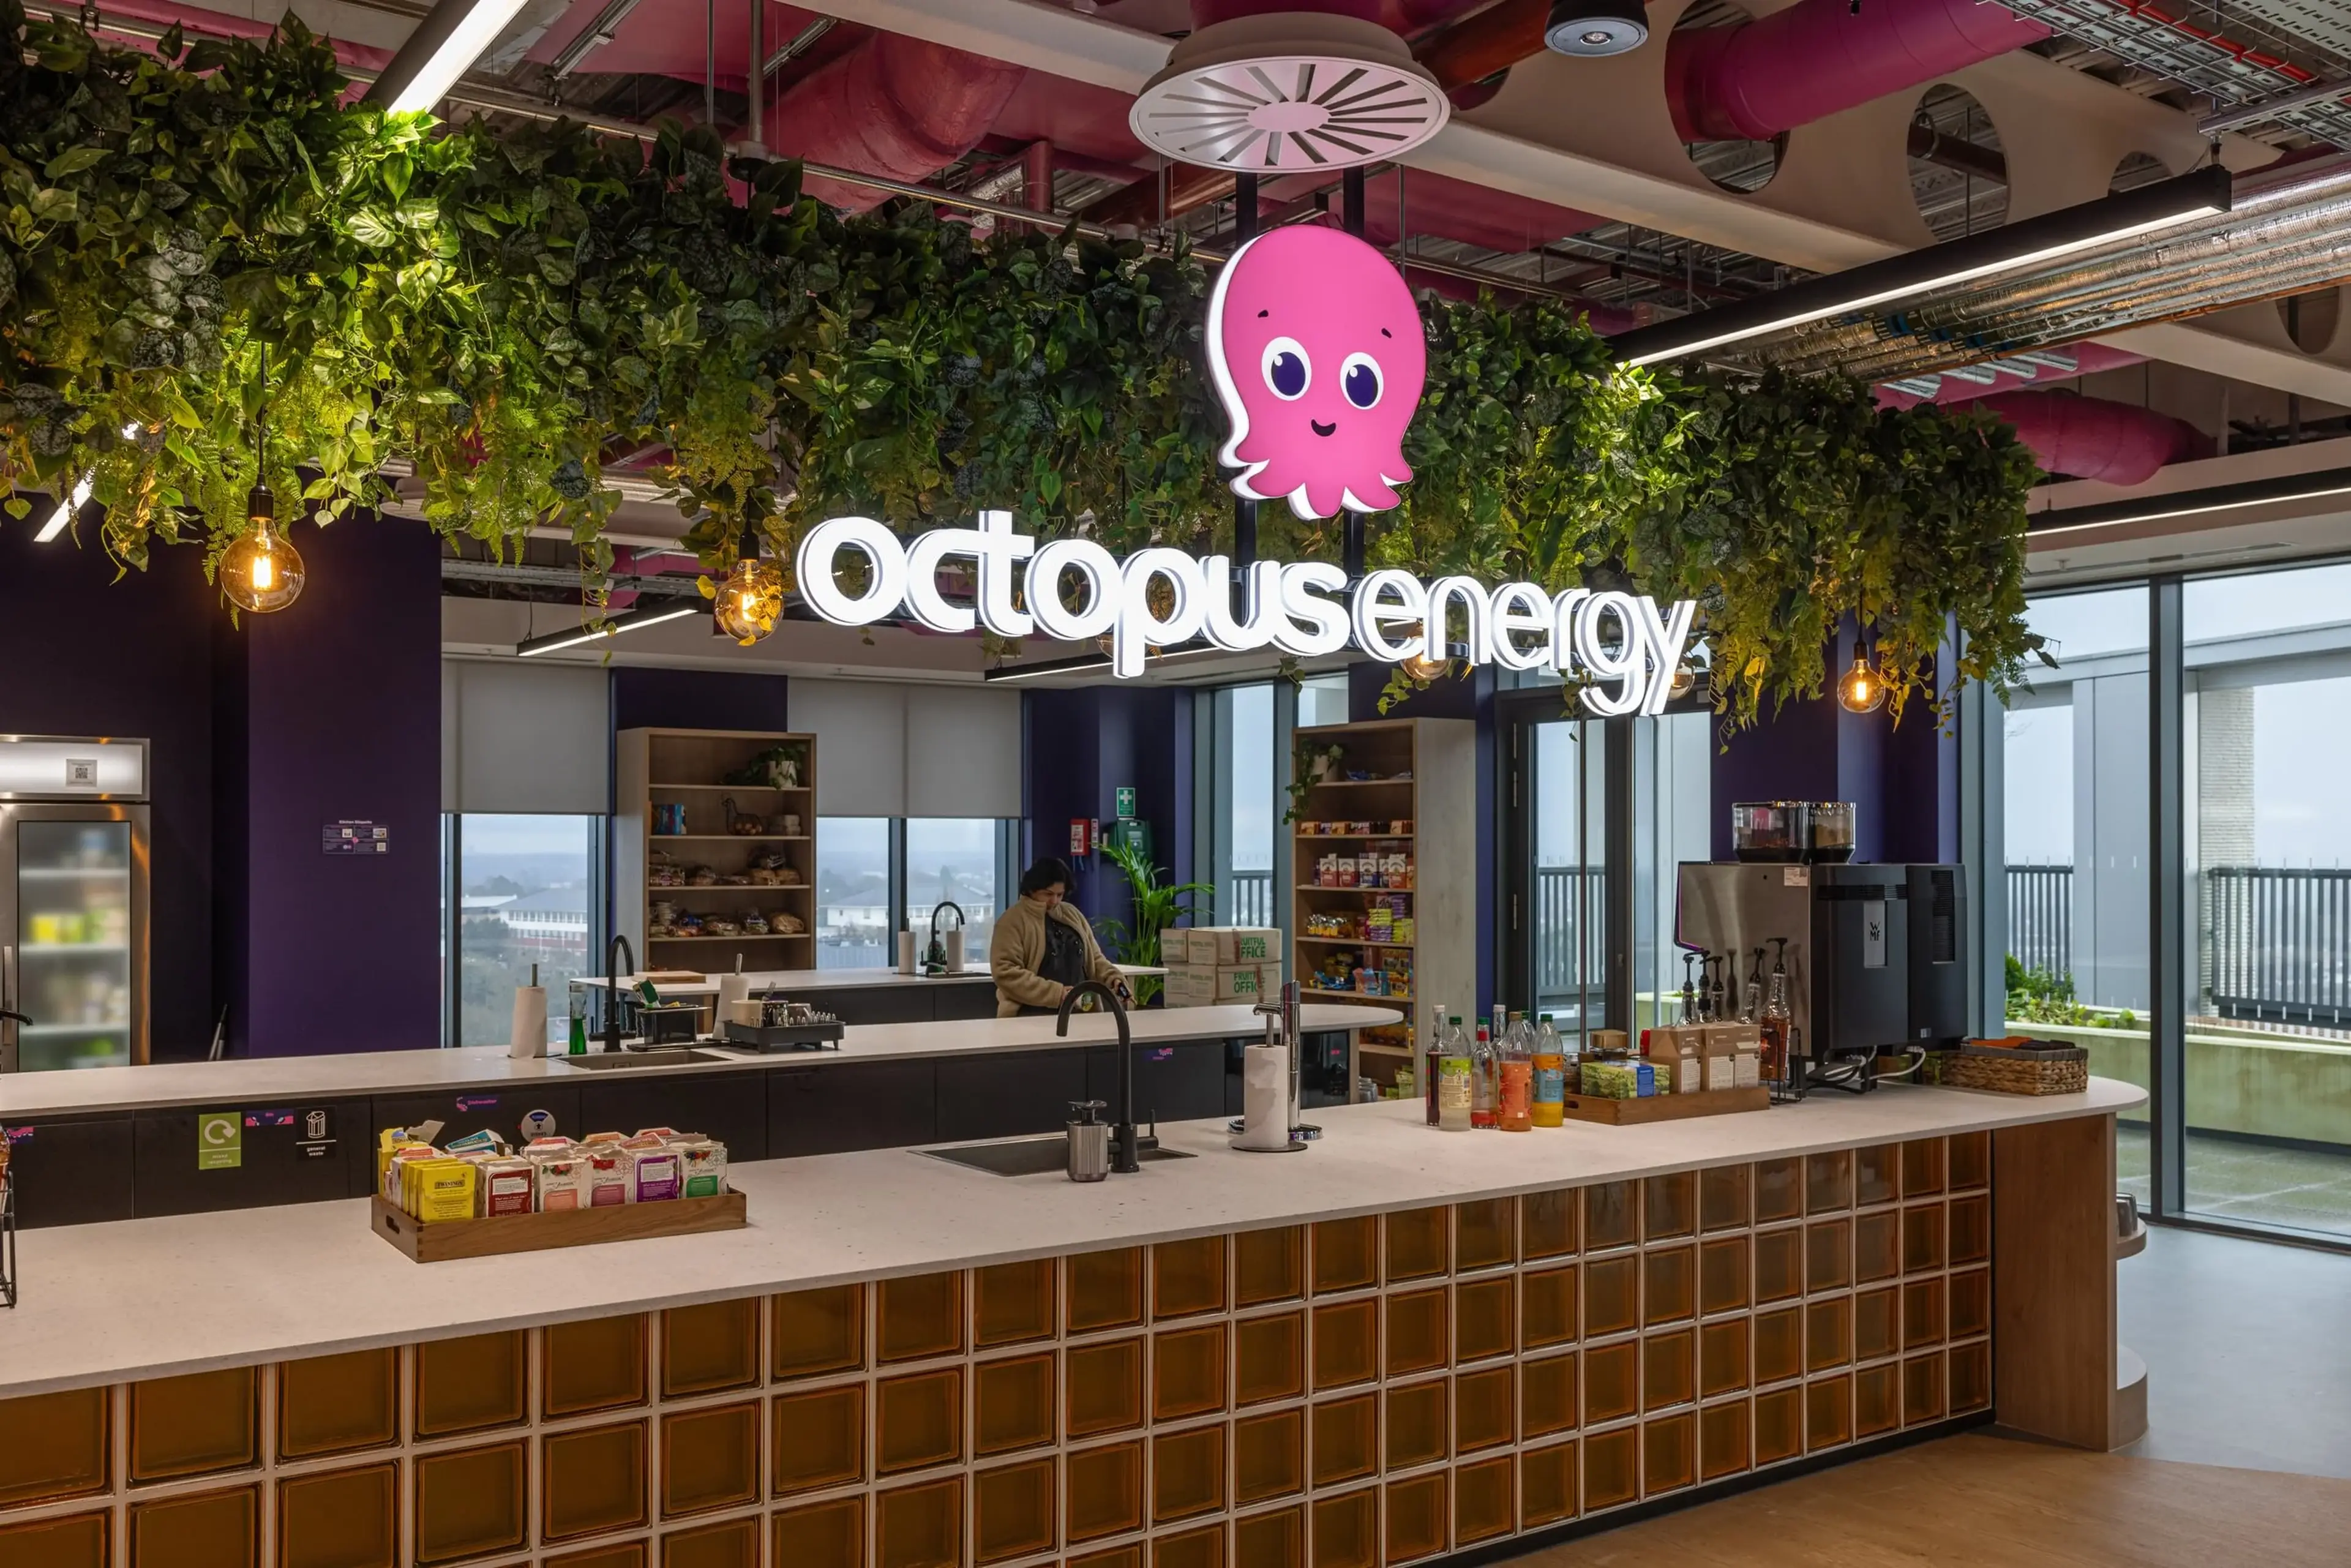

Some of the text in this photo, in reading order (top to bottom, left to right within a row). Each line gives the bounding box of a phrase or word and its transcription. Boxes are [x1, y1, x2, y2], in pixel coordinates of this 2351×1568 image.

[796, 509, 1697, 716] octopus energy
[1240, 946, 1266, 958] FFICE
